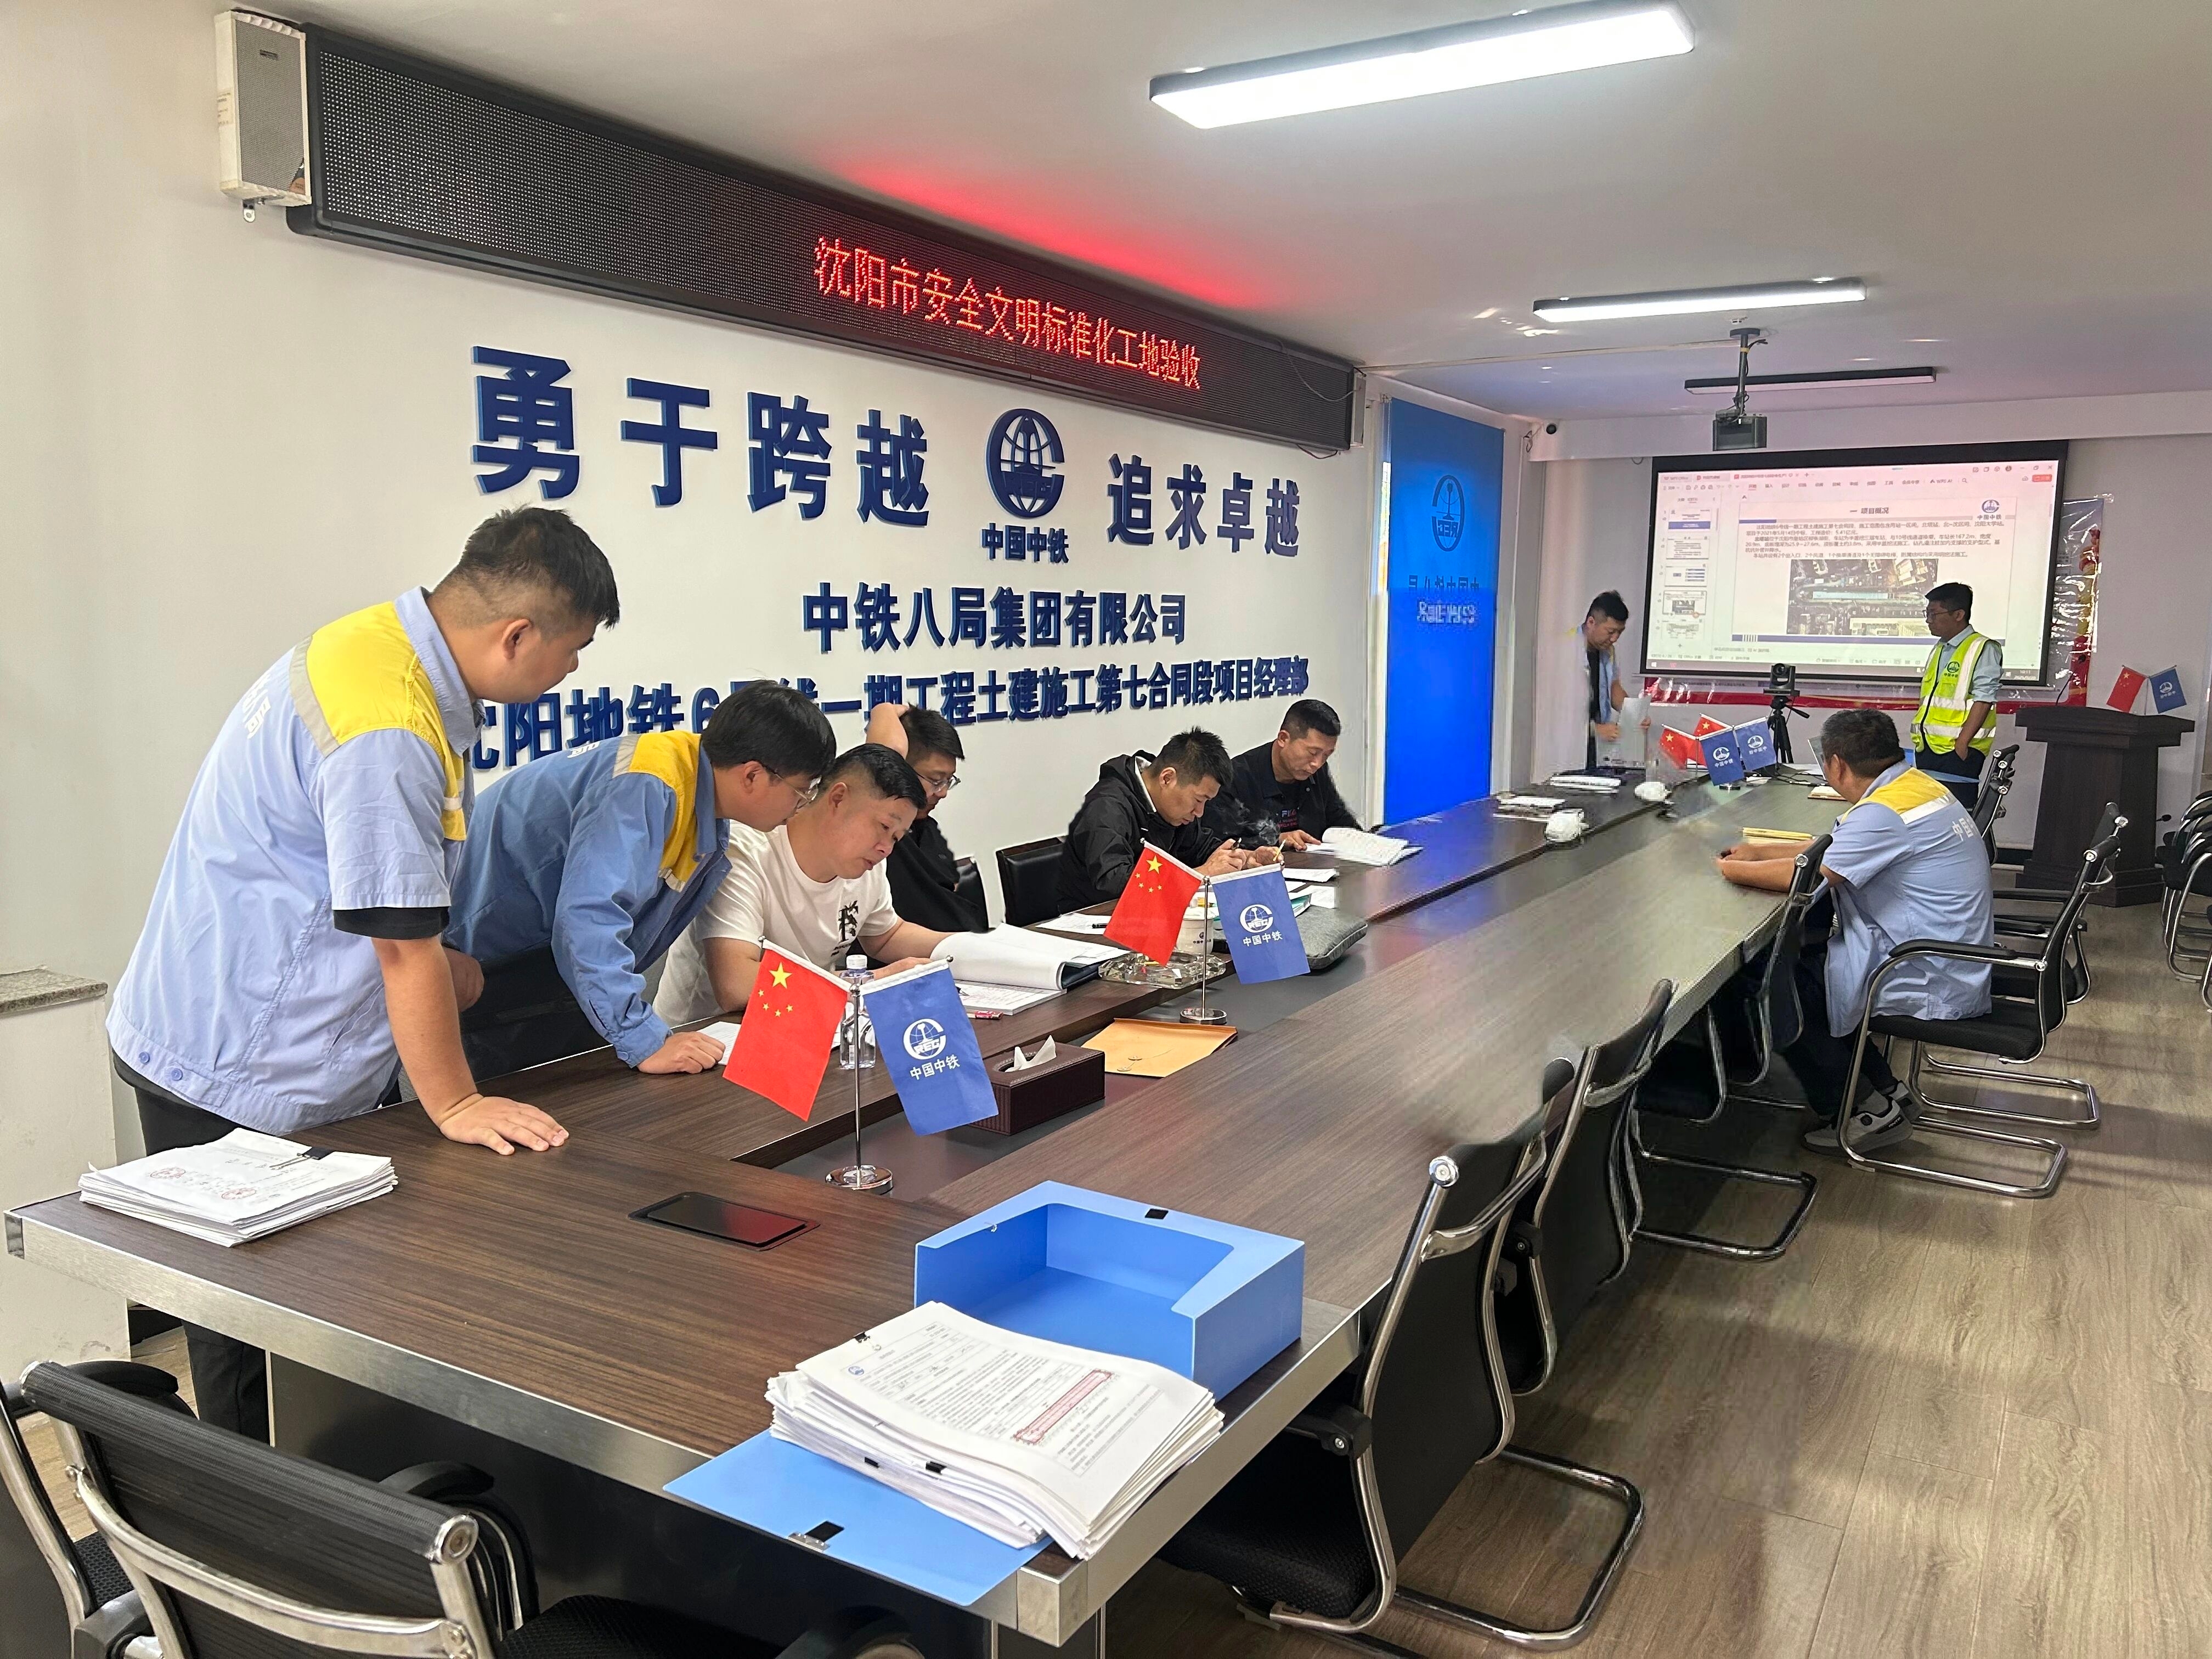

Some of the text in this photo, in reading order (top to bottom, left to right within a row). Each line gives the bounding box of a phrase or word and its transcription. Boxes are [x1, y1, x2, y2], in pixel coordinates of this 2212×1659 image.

[814, 236, 1200, 390] 沈阳市安全文明标准化工地验收
[472, 345, 1300, 557] 勇于跨越 追求卓越
[981, 522, 1069, 563] 中国中铁
[803, 582, 1186, 653] 中铁八局集团有限公司
[472, 655, 1310, 769] 阳地铁6一期工程土建施工第七合同段项目经理部
[1243, 930, 1283, 947] 中国中铁
[910, 1054, 961, 1080] 中国中铁
